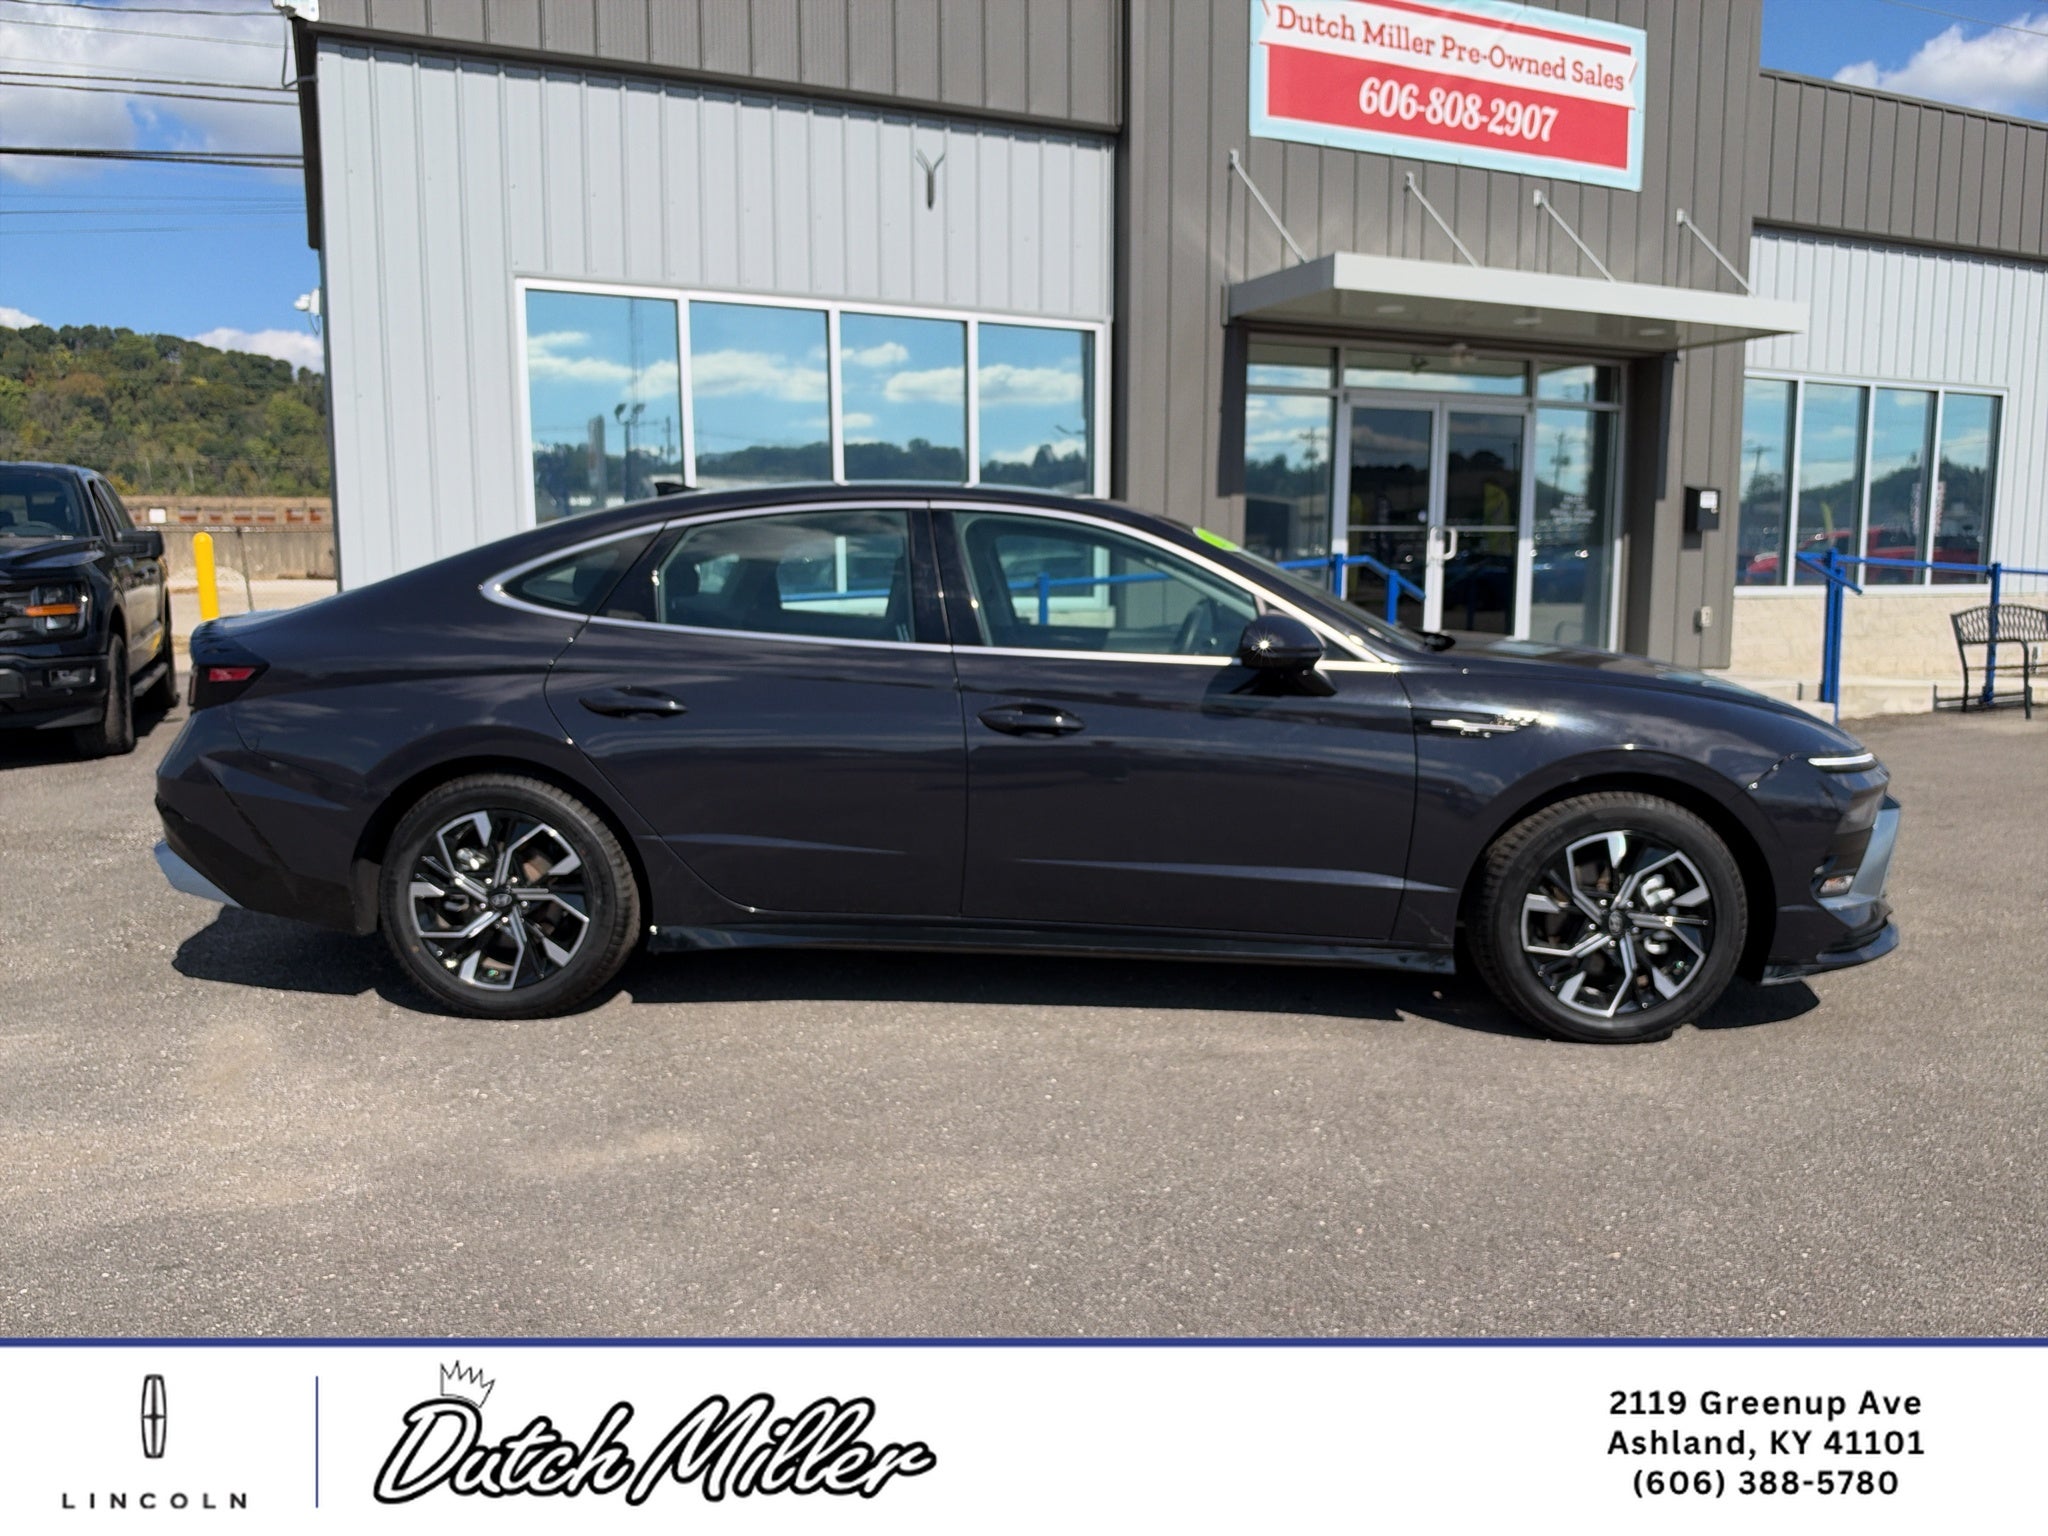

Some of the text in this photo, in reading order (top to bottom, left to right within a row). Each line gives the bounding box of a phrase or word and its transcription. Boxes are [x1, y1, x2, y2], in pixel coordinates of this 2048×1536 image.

[1276, 4, 1625, 91] Dutch Miller Pre-Owned Sales
[1359, 76, 1559, 143] 606-808-2907
